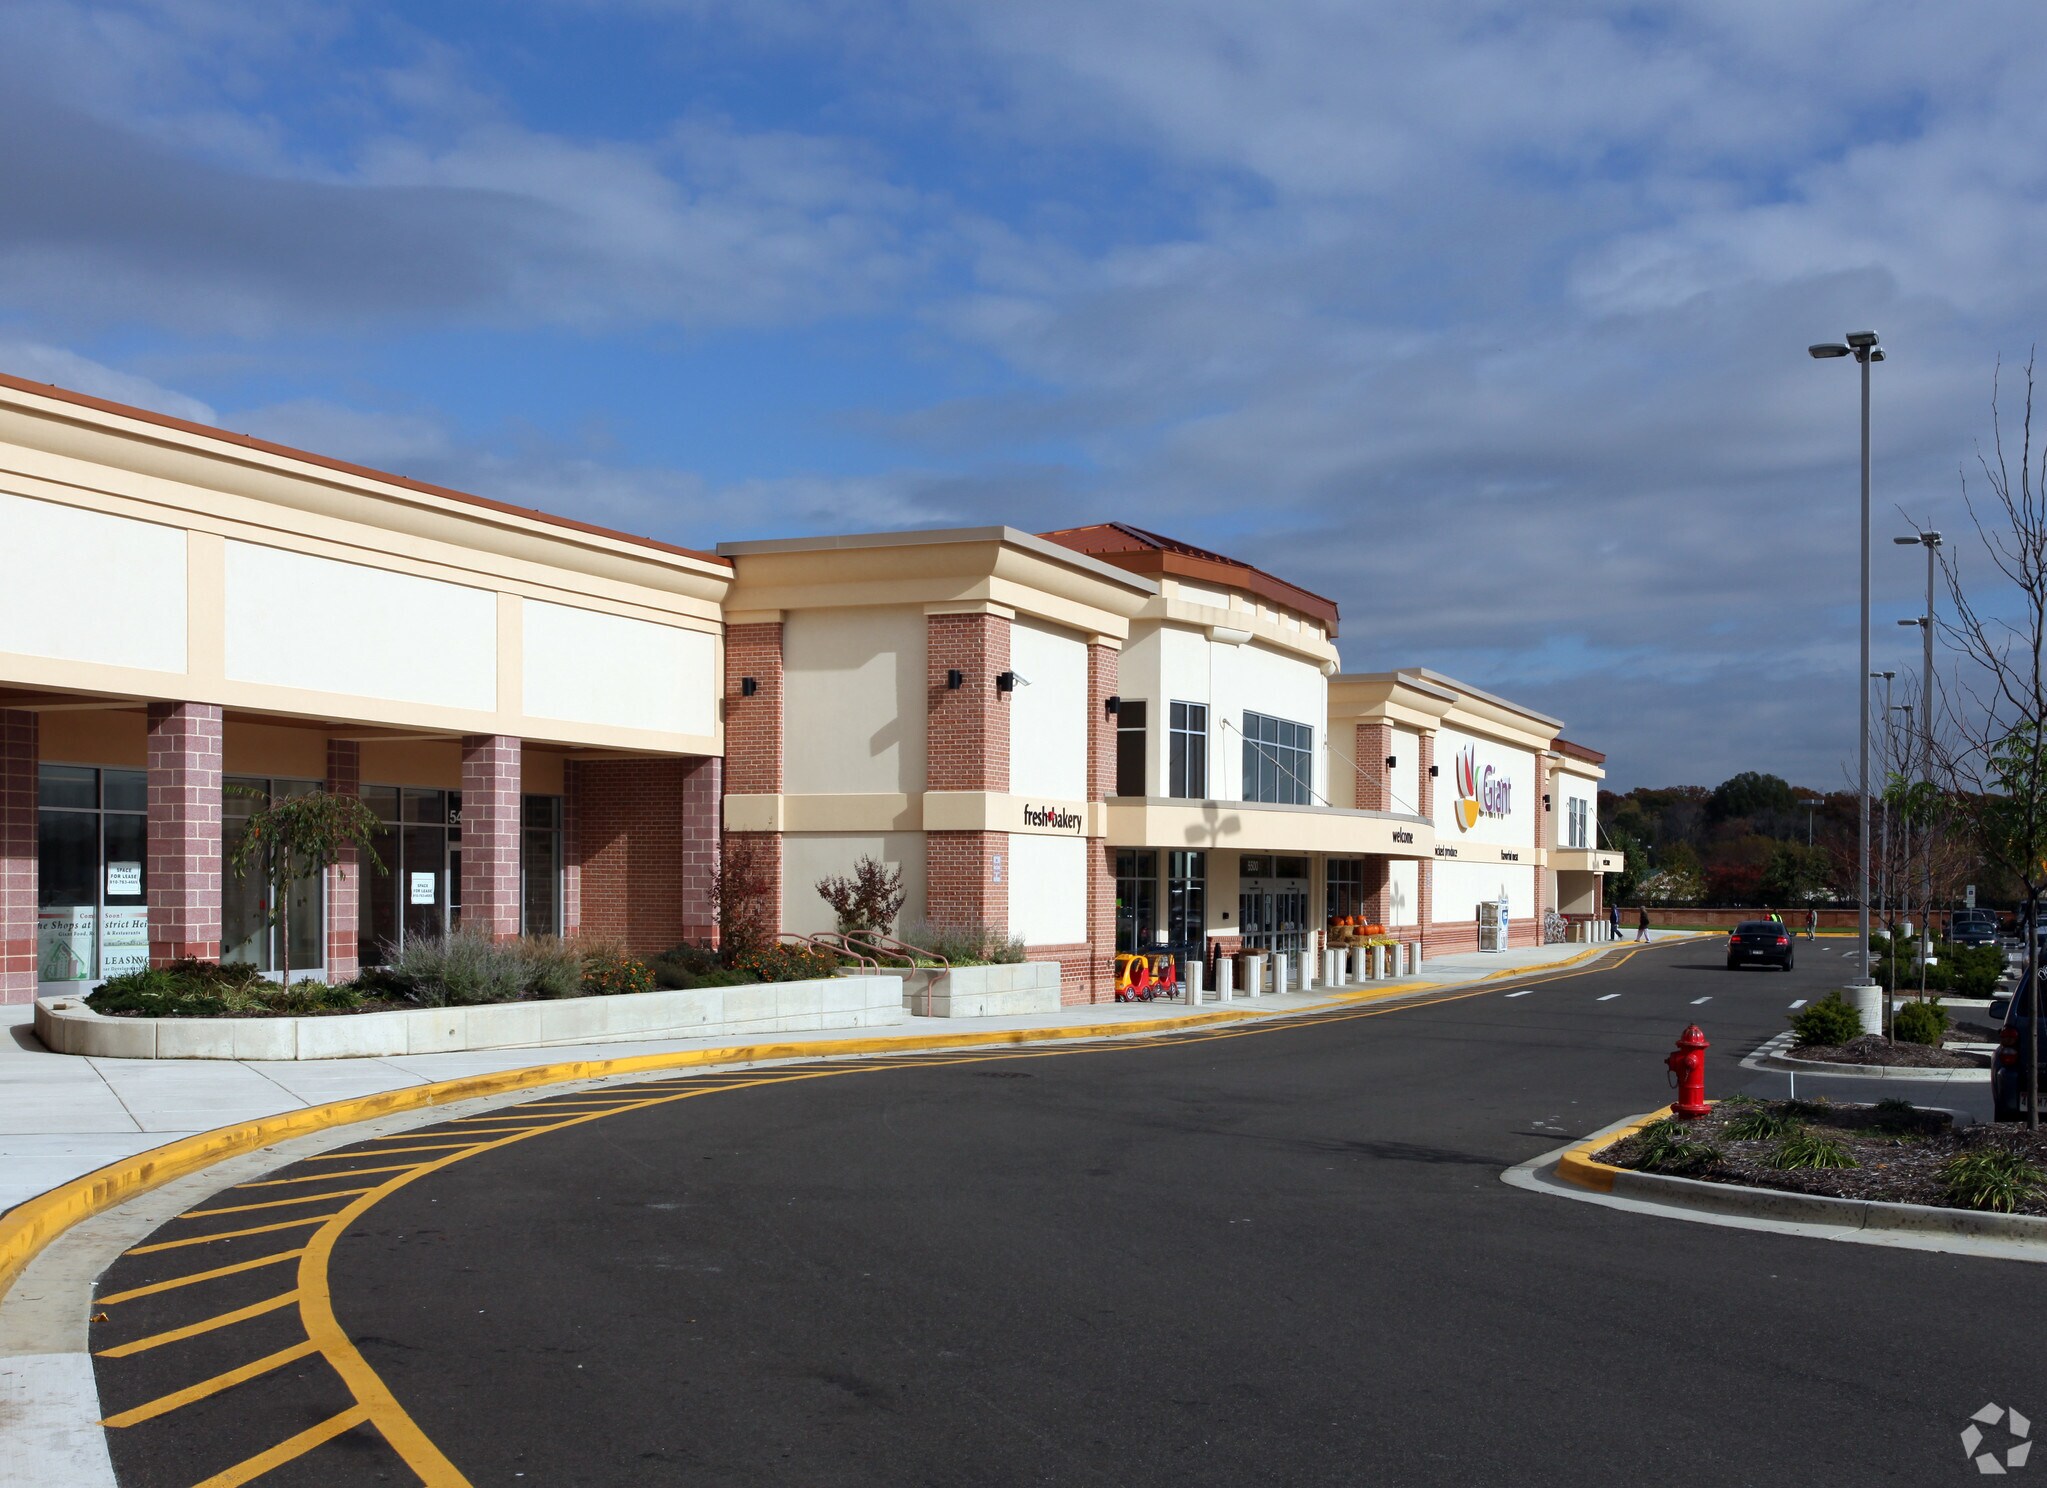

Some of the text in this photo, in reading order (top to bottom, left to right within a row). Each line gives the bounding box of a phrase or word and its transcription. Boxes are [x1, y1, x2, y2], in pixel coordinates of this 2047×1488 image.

[1483, 764, 1511, 815] Giant
[450, 810, 462, 824] 54
[1024, 803, 1082, 834] fresh bakery
[1392, 826, 1414, 844] welcome
[51, 920, 79, 931] Shops
[81, 921, 91, 929] at
[103, 920, 129, 929] strict
